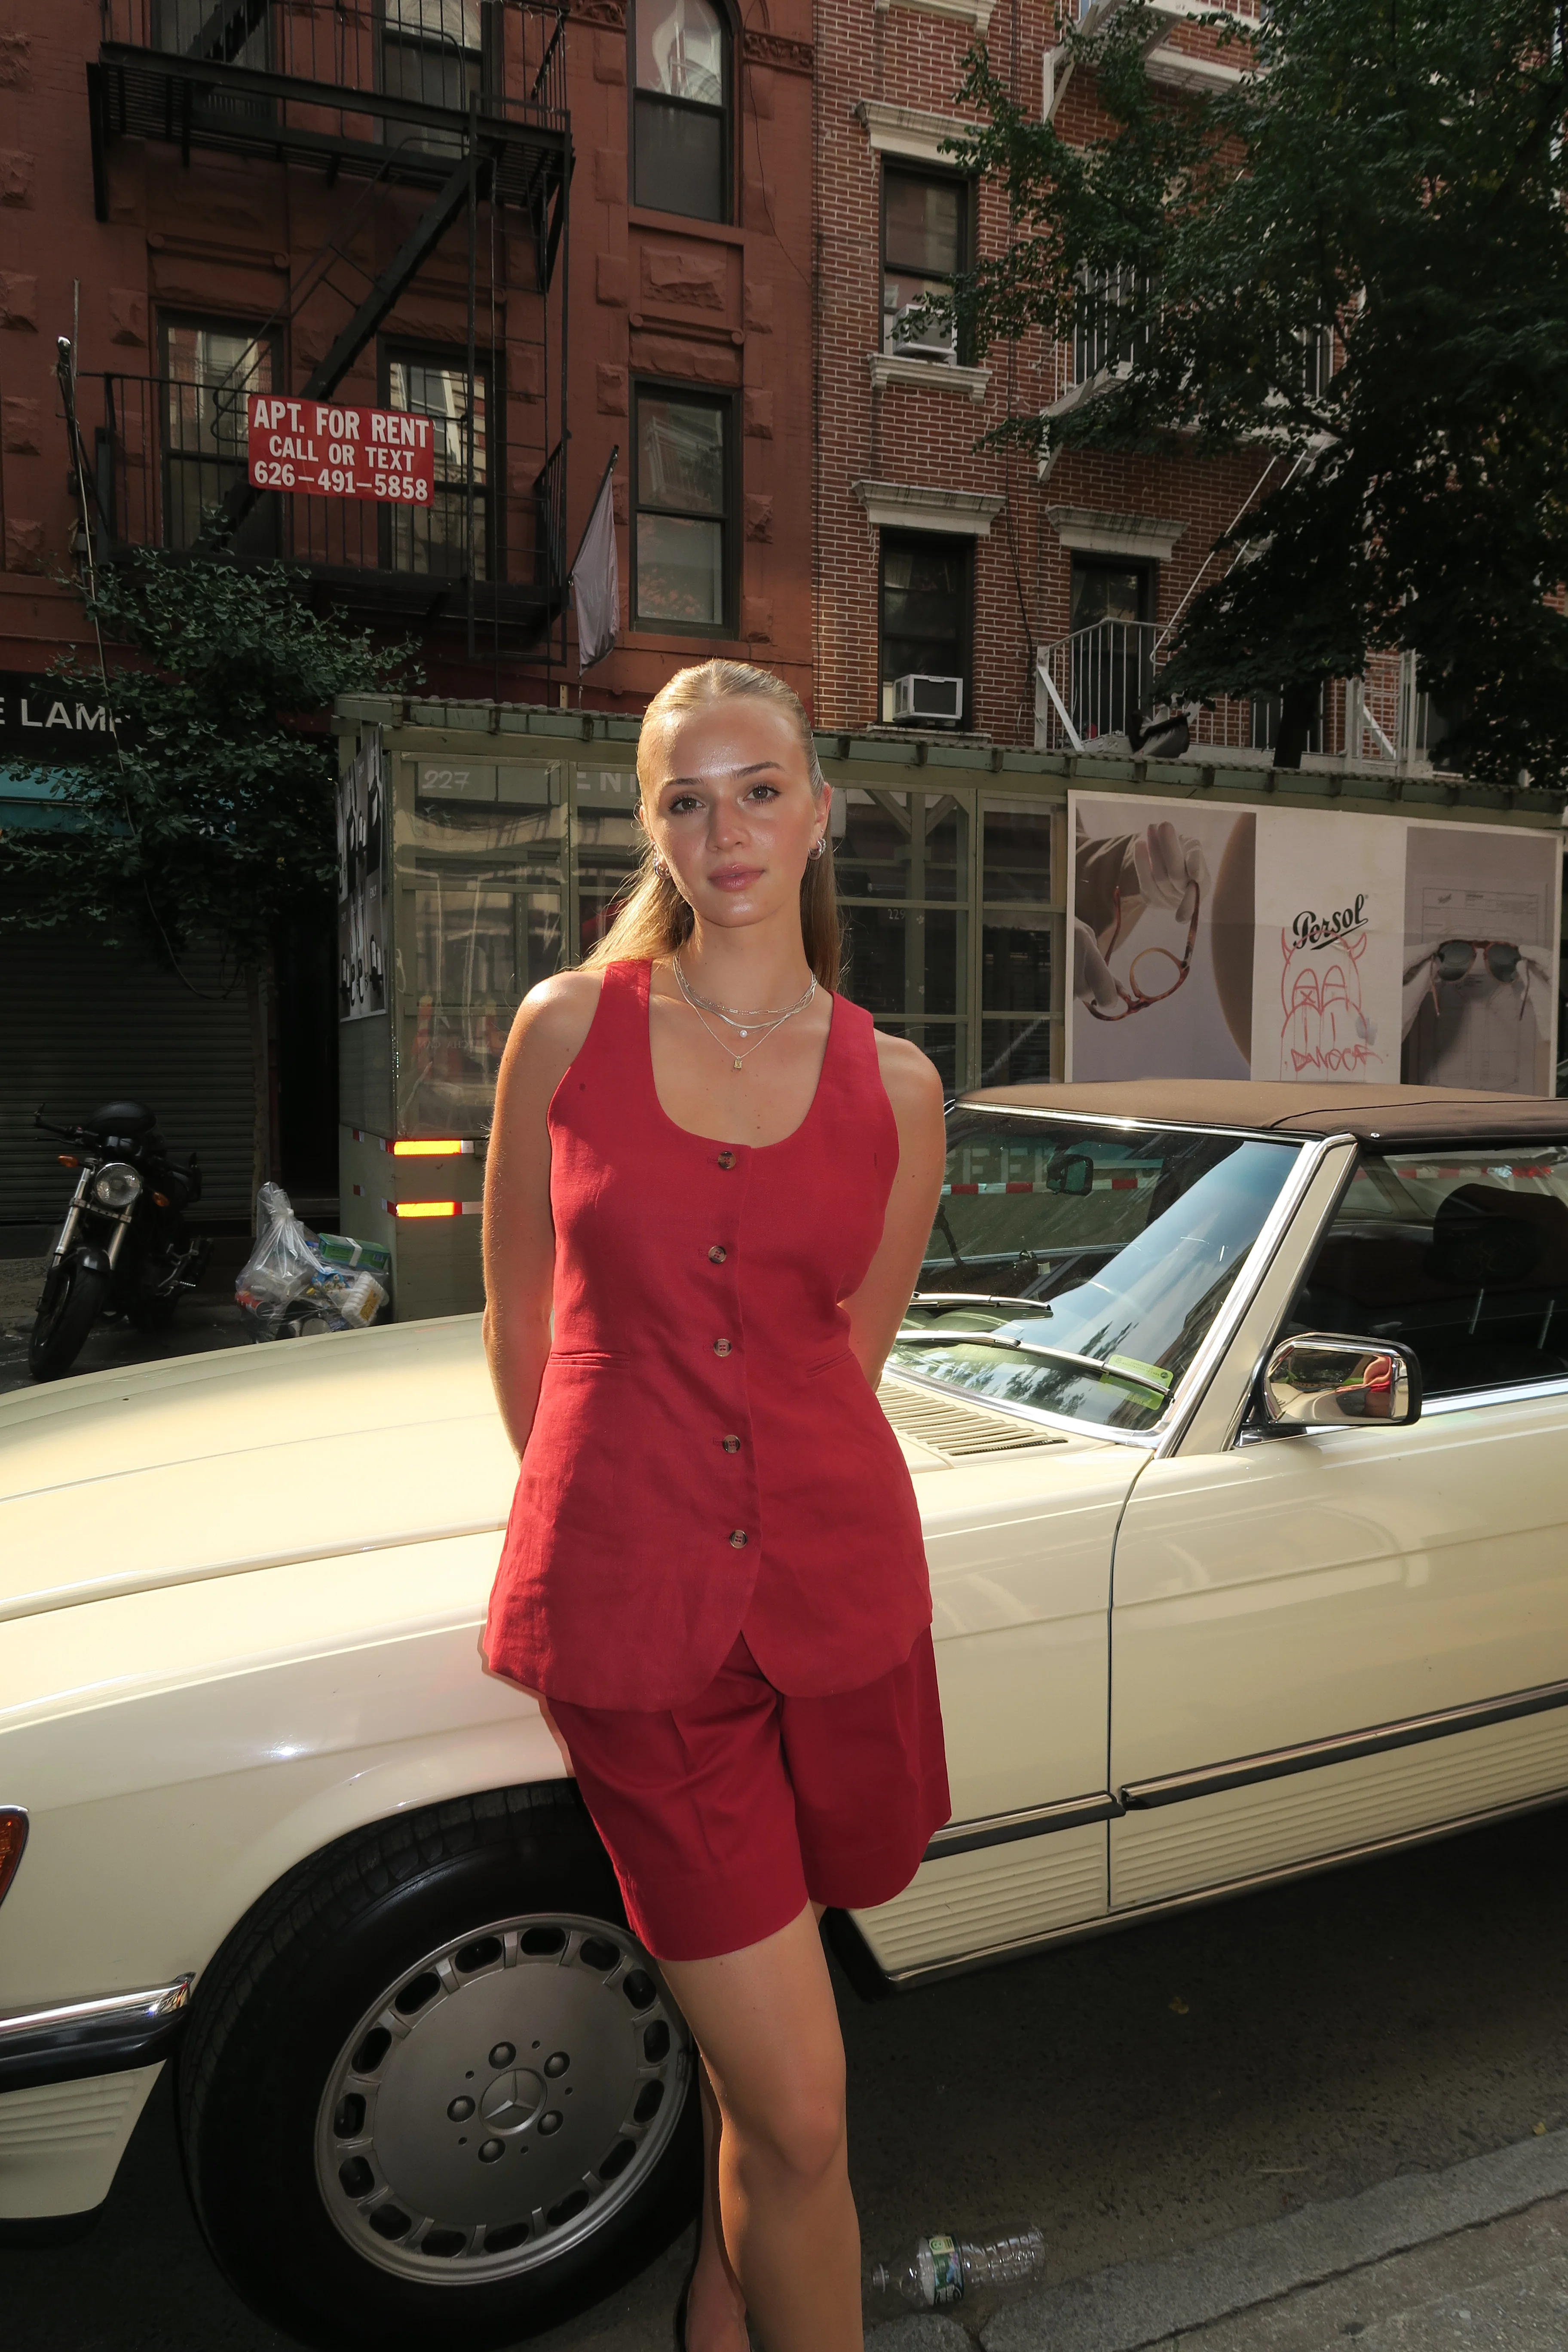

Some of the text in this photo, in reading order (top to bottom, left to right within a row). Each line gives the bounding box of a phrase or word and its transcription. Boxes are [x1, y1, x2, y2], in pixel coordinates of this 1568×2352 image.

[254, 399, 429, 448] APT. FOR RENT
[269, 435, 414, 472] CALL OR TEXT
[254, 461, 428, 501] 626-491-5858
[422, 770, 470, 792] 227
[888, 908, 905, 920] 229
[1293, 894, 1369, 950] Persol
